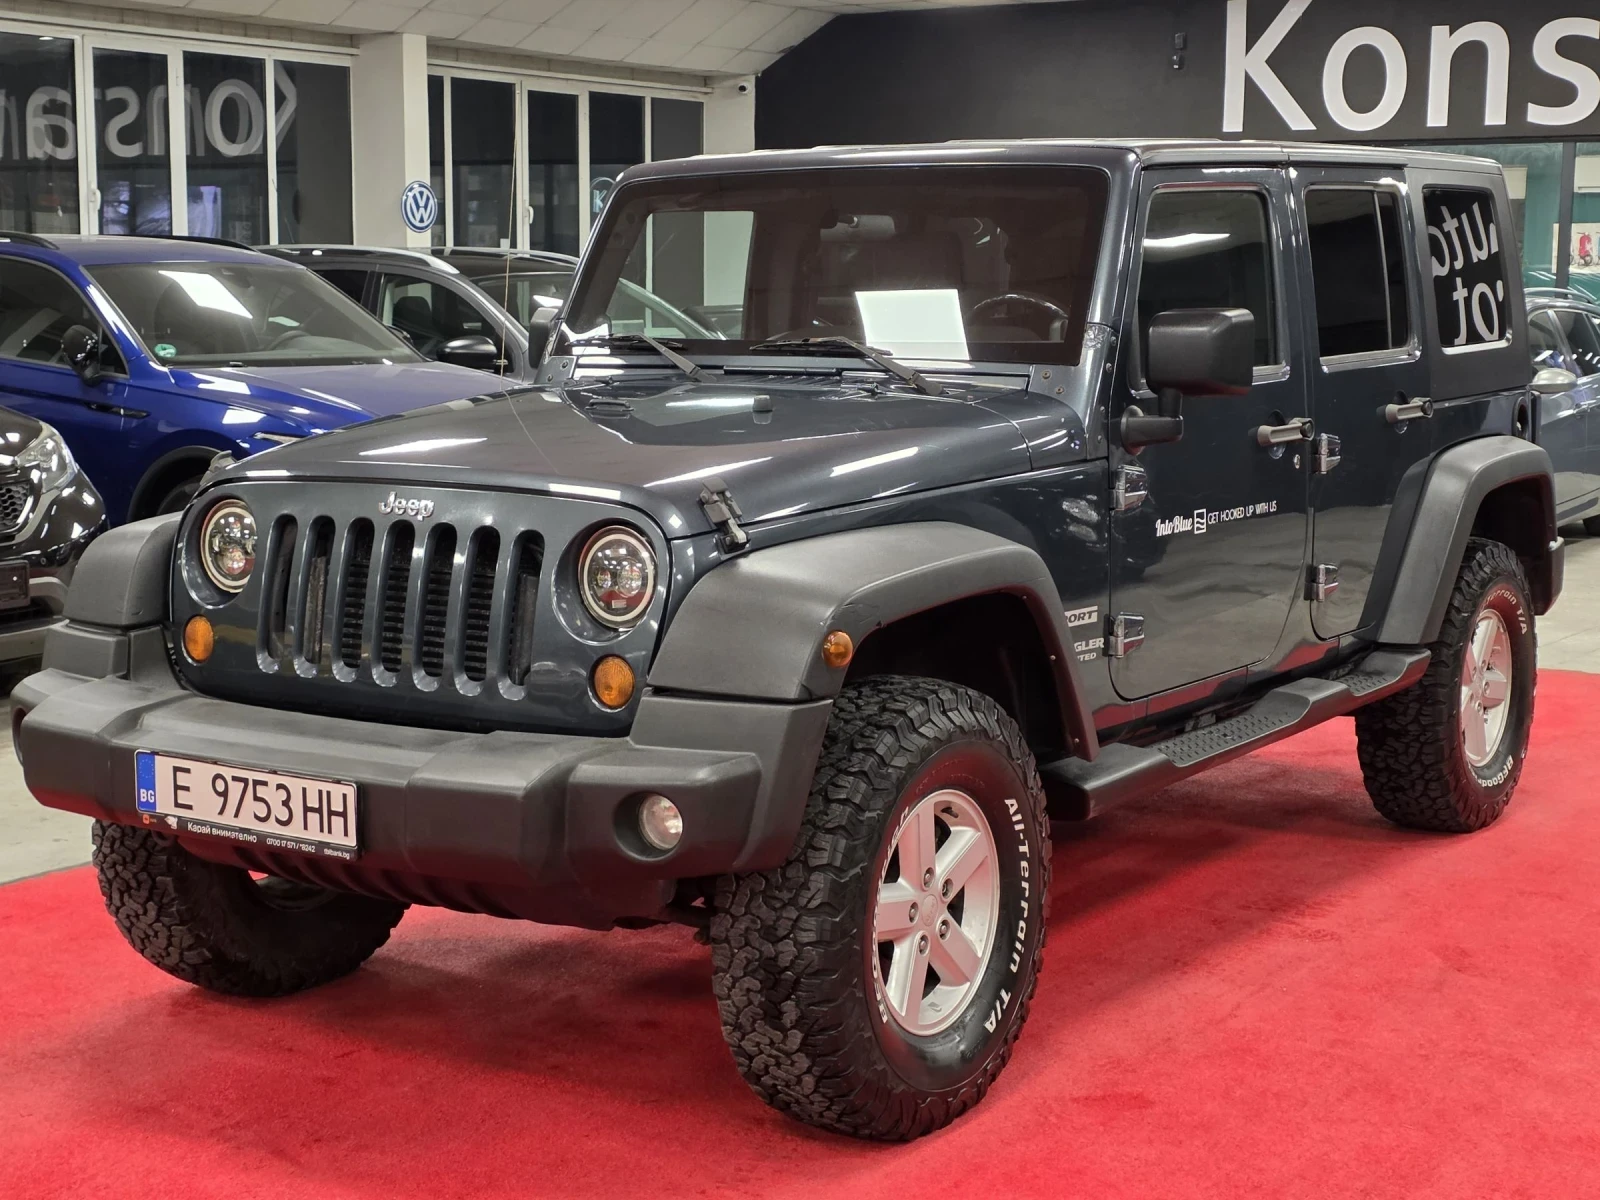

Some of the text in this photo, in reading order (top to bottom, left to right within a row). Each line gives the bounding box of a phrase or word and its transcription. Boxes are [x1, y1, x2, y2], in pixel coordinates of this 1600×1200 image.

[1222, 0, 1600, 133] Kons
[379, 491, 434, 521] Jeep
[1207, 511, 1220, 525] GET
[1220, 507, 1244, 521] HOOKED
[1246, 505, 1254, 517] UP
[1255, 502, 1269, 515] WITH
[1269, 500, 1277, 512] US
[1066, 611, 1094, 624] ORT
[140, 788, 155, 802] BG
[172, 765, 349, 838] E 9753 HH
[187, 821, 257, 843] Карай внимателно
